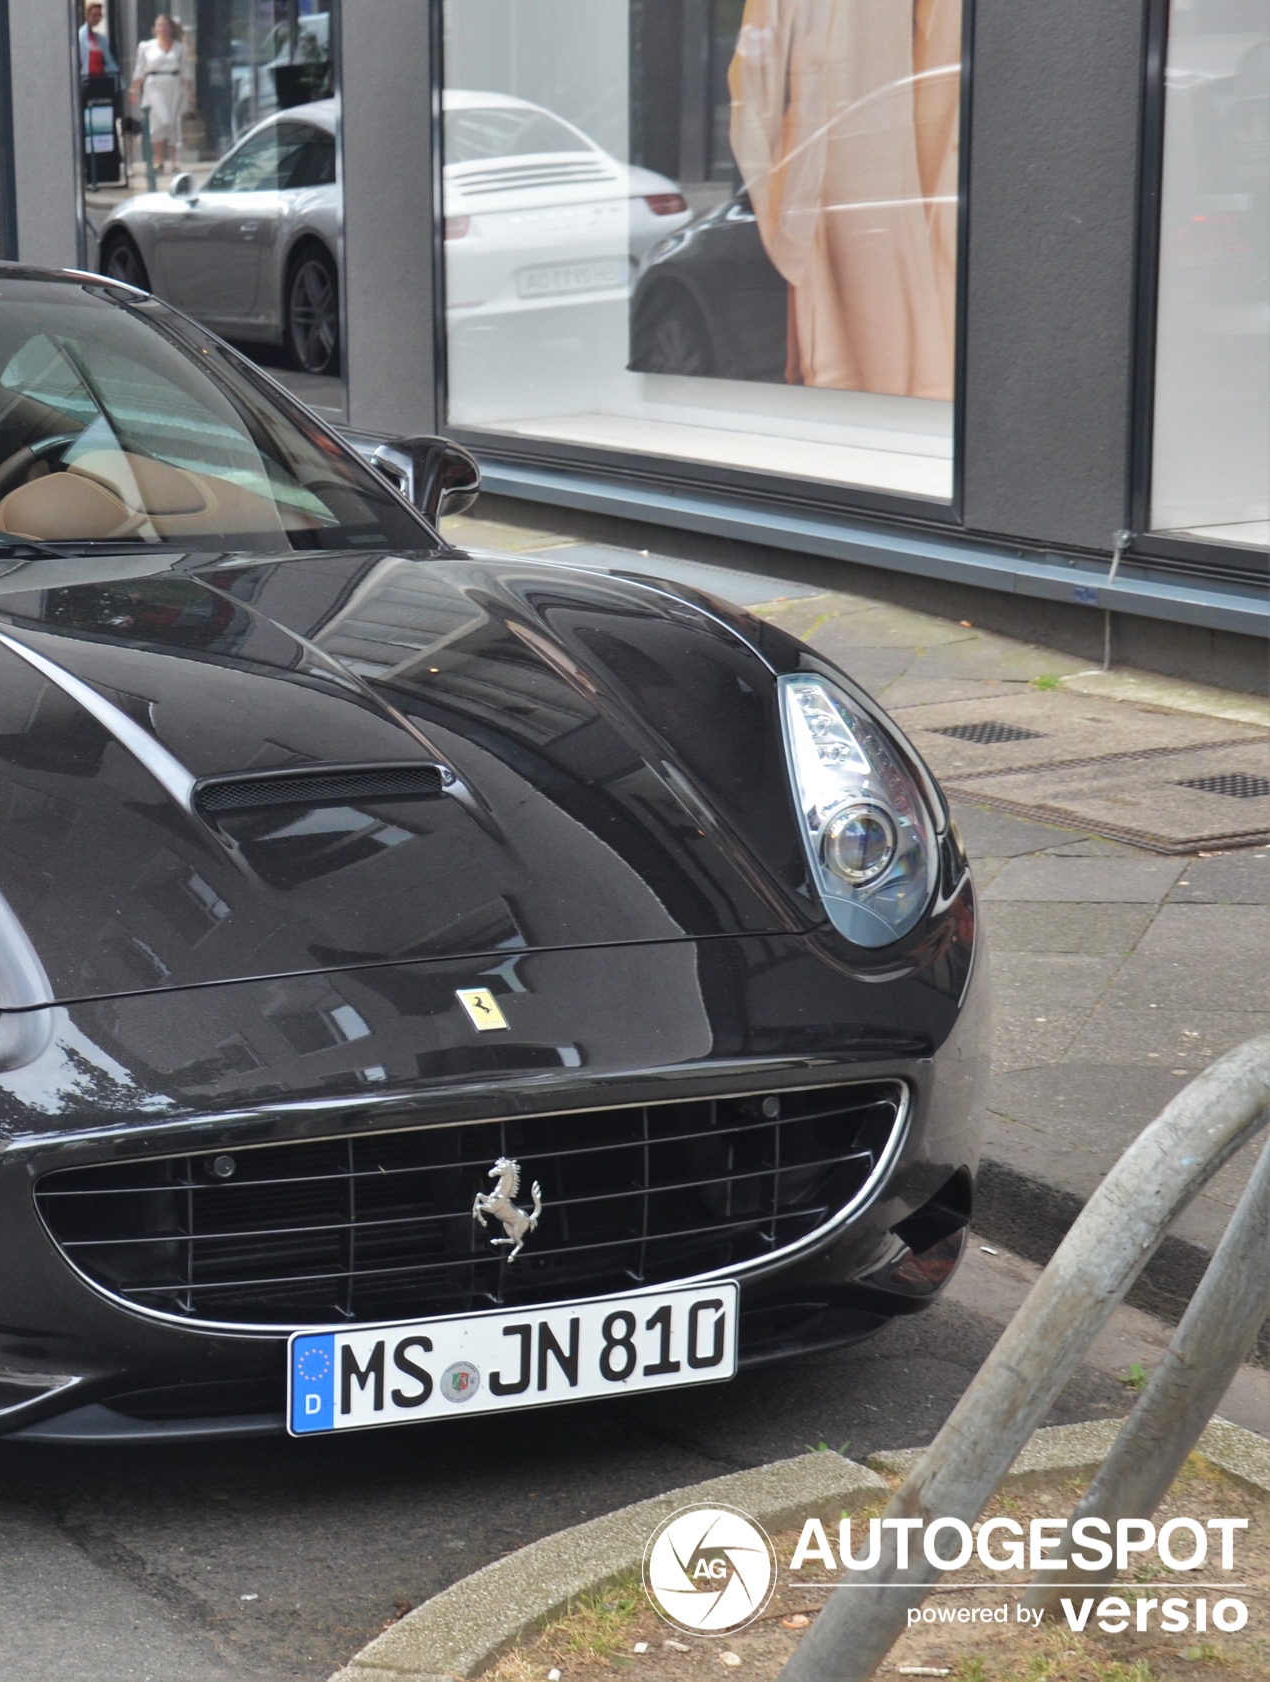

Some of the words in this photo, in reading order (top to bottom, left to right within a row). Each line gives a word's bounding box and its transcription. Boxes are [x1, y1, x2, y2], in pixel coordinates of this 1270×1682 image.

[305, 1394, 321, 1415] D
[340, 1336, 434, 1415] MS
[488, 1317, 580, 1396] JN
[599, 1298, 726, 1382] 810
